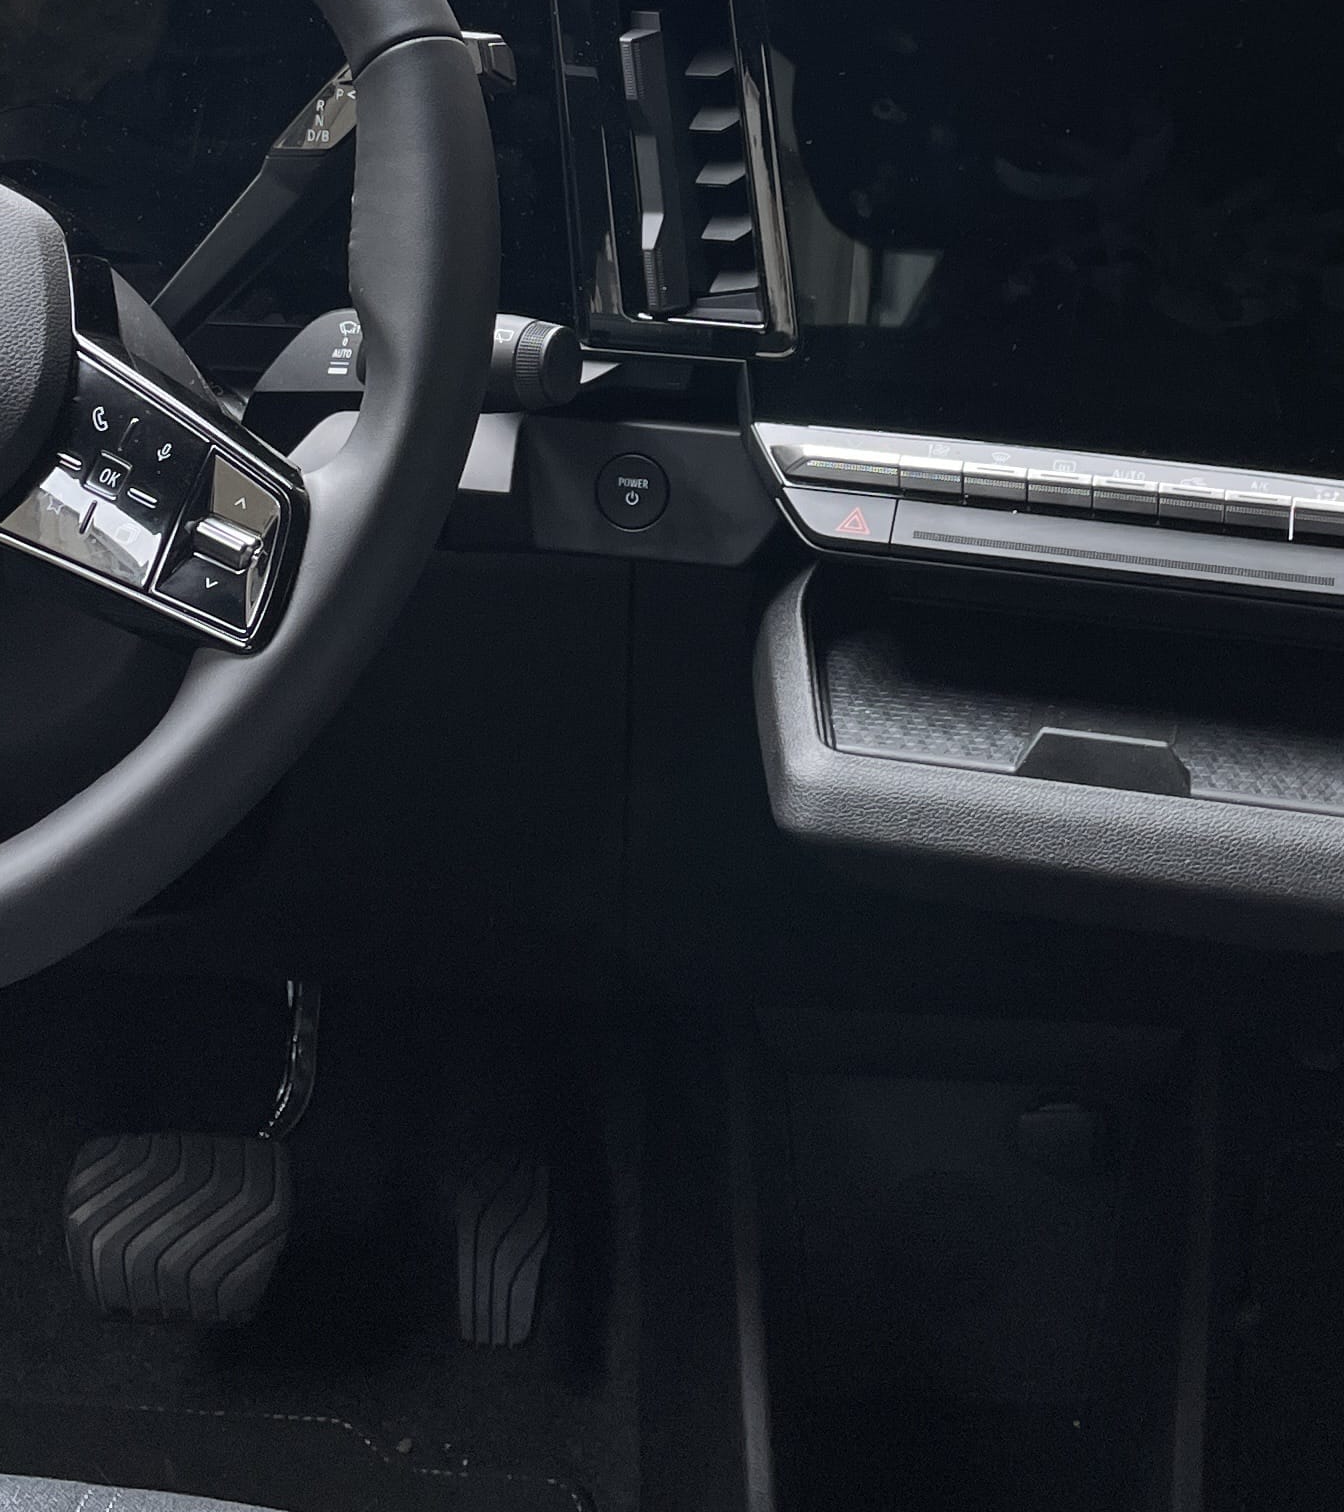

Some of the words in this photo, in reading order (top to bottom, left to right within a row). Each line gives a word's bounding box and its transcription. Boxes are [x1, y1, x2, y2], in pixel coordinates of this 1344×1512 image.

[316, 99, 325, 111] R
[315, 114, 324, 126] N
[307, 129, 330, 142] D/B
[331, 348, 353, 359] AUTO
[99, 468, 121, 488] OK
[618, 476, 649, 489] POWER
